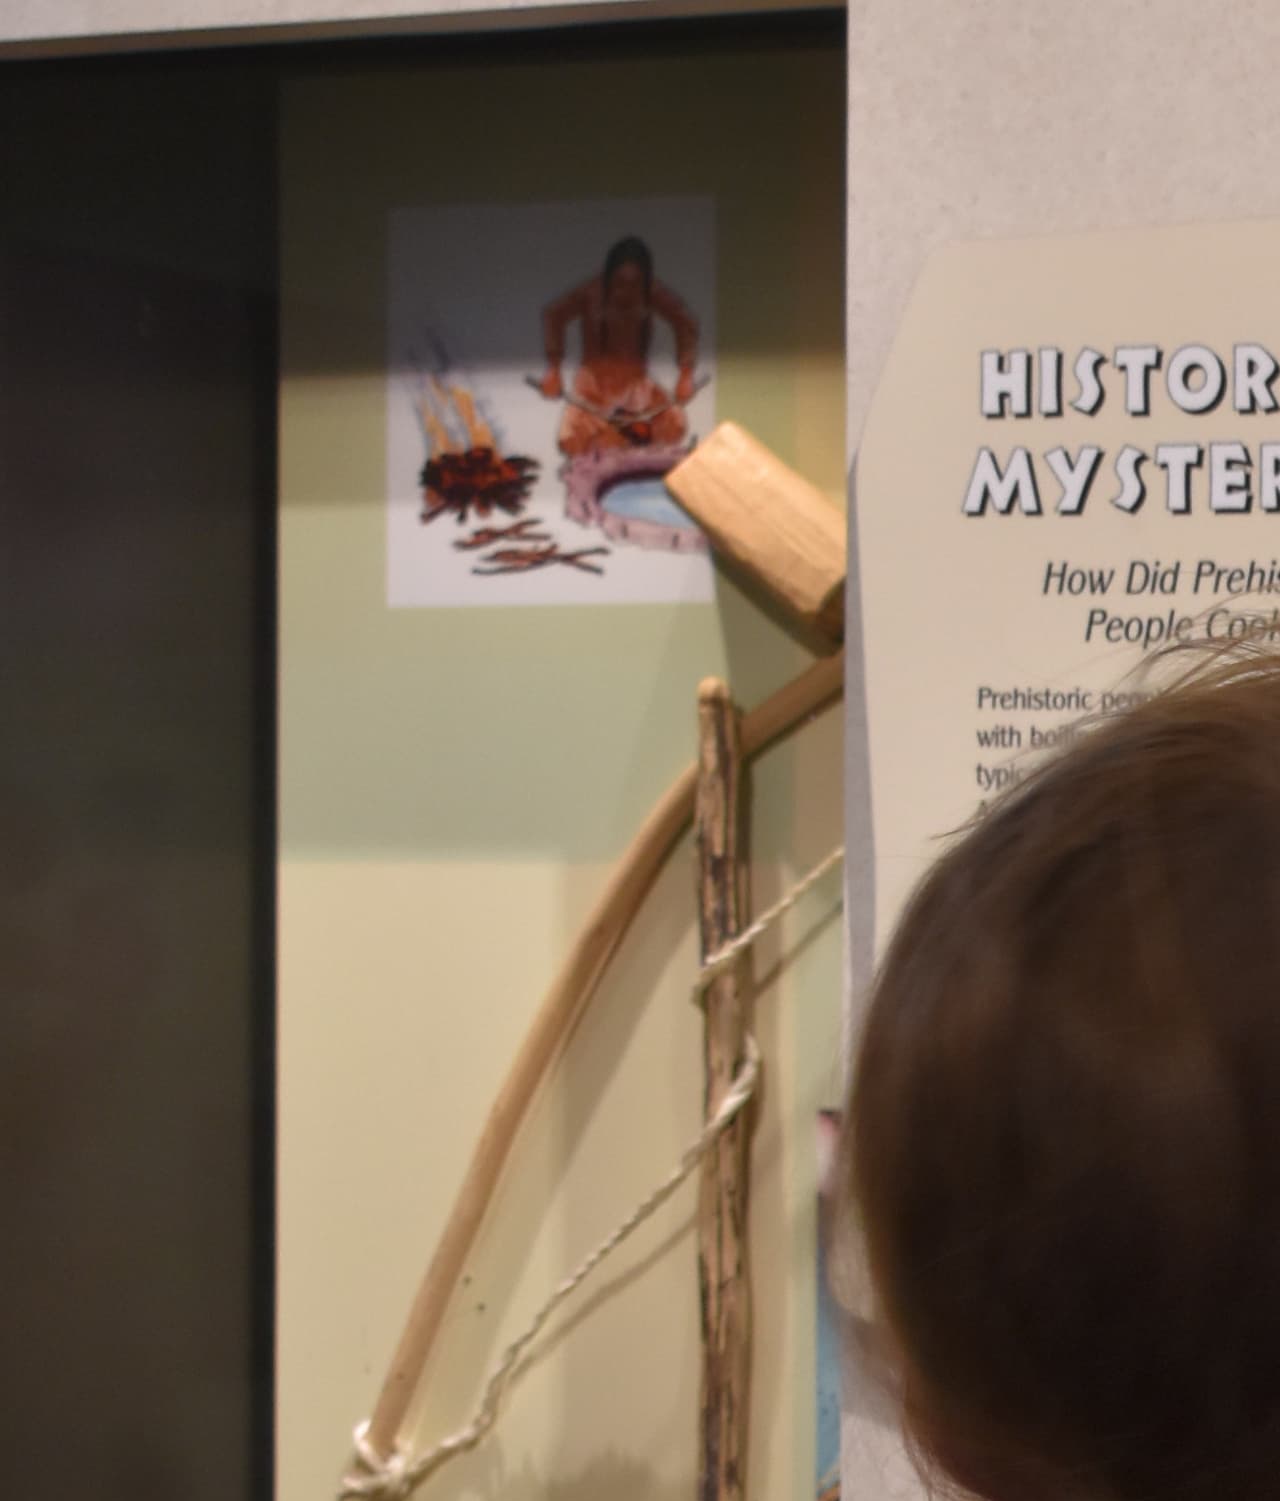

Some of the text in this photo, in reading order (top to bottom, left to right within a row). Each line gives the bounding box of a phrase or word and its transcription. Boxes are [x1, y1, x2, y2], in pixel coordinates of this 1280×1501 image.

[1042, 561, 1114, 596] How
[1126, 560, 1179, 595] Did
[1085, 608, 1194, 649] People
[977, 686, 1092, 711] Prehistoric
[976, 724, 1021, 749] with
